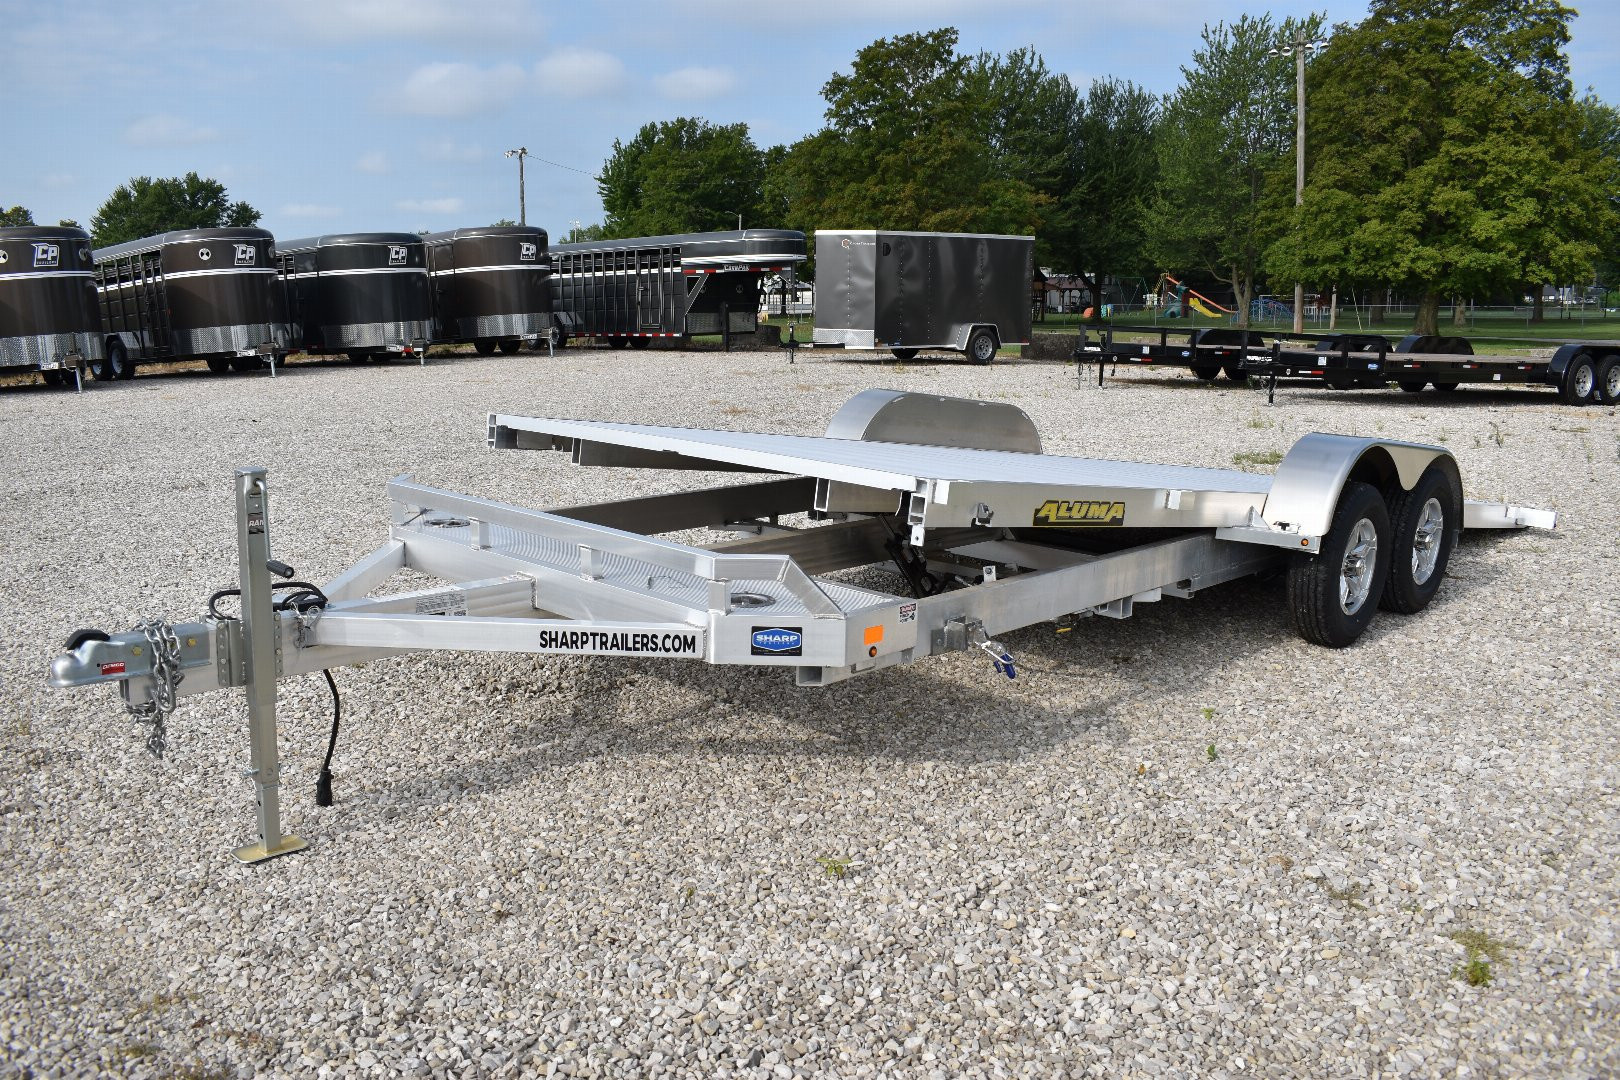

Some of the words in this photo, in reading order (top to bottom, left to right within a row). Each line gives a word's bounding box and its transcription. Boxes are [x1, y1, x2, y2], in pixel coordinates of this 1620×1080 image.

[37, 245, 58, 261] CP
[238, 246, 254, 260] CP
[392, 247, 406, 260] CP
[1035, 500, 1125, 523] ALUMA
[539, 630, 696, 653] SHARPTRAILERS.COM
[756, 634, 798, 642] SHARP
